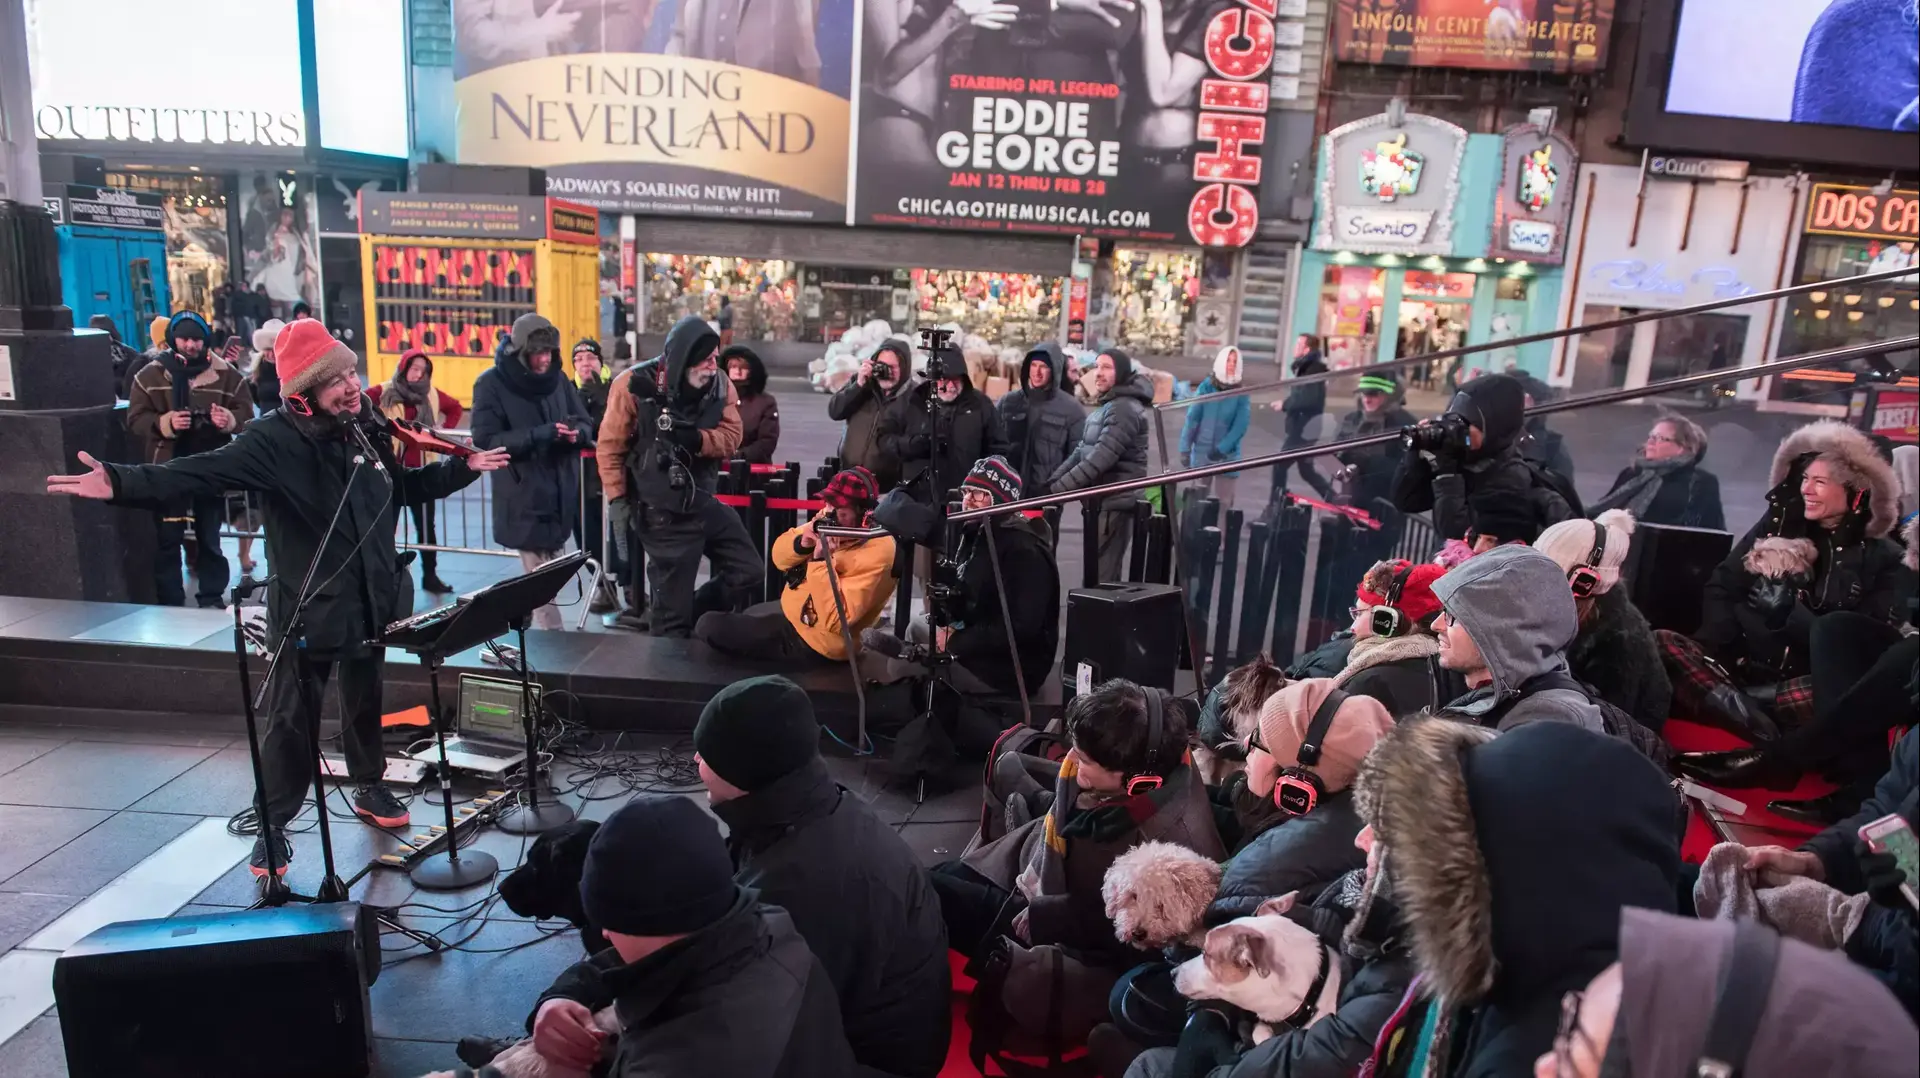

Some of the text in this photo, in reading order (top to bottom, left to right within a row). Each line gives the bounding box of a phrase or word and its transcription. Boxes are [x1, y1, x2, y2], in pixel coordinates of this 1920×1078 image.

[1352, 12, 1429, 33] LINCOLN
[565, 63, 742, 101] FINDING
[950, 74, 1120, 98] STARRING NFL LEGEND
[37, 104, 302, 145] OUTFITTERS
[490, 92, 816, 158] NEVERLAND
[972, 96, 1090, 138] EDDIE
[1187, 0, 1277, 247] CHIC
[936, 130, 1121, 177] GEORGE
[625, 181, 700, 199] SOARING
[704, 184, 742, 202] NEW
[745, 187, 780, 203] HIT!
[949, 172, 1106, 196] JAN 12 THRU FEB 28
[898, 197, 1150, 228] CHICAGOTHEMUSICAL.COM
[1814, 191, 1878, 230] DOS
